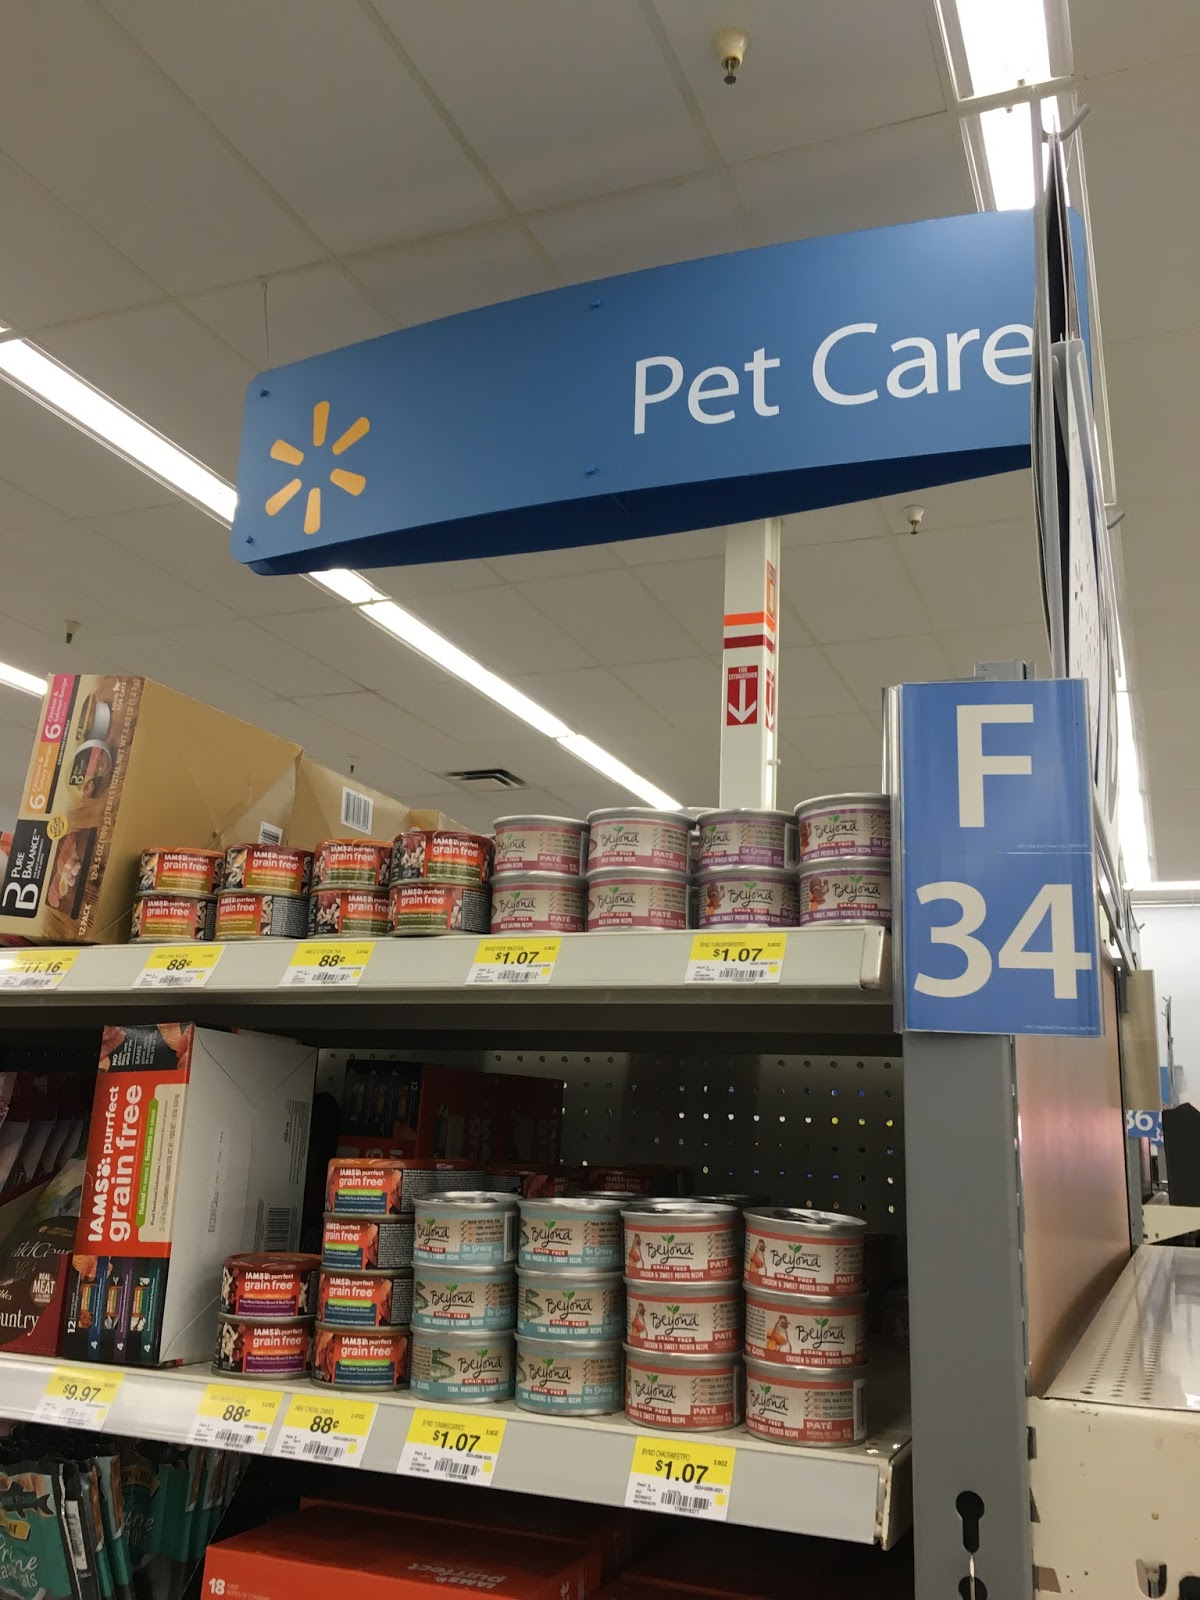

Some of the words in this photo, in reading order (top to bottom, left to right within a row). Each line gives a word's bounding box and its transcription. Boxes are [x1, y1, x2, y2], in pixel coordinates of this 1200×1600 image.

[634, 347, 781, 436] Pet
[812, 322, 1032, 407] Care
[45, 724, 61, 739] 6
[956, 703, 1034, 828] F
[111, 765, 121, 789] TOTAL
[29, 794, 45, 809] 6
[814, 822, 859, 841] Beyond
[601, 832, 640, 850] Beyond
[22, 834, 40, 879] BALANCE
[330, 852, 352, 862] grain
[354, 853, 374, 861] free
[433, 846, 459, 855] grain
[461, 848, 478, 857] free
[539, 854, 562, 862] PATÉ
[653, 850, 674, 859] PATÉ
[11, 852, 25, 878] PURE
[163, 861, 188, 870] grain
[189, 862, 207, 871] free
[252, 859, 277, 868] grain
[279, 860, 298, 869] free
[401, 895, 422, 905] grain
[424, 895, 444, 905] free
[728, 889, 773, 907] Beyond
[832, 883, 881, 902] Beyond
[147, 906, 168, 916] grain
[170, 906, 189, 915] free
[220, 904, 235, 913] grain
[347, 902, 373, 912] grain
[500, 899, 536, 916] Beyond
[598, 894, 635, 911] Beyond
[81, 904, 92, 926] PACK
[550, 914, 571, 923] PATÉ
[650, 910, 671, 918] PATÉ
[79, 926, 87, 936] 12
[914, 881, 1092, 1000] 34
[495, 952, 540, 964] $1.07
[713, 948, 763, 962] $1.07
[115, 1084, 142, 1150] free
[88, 1179, 109, 1242] IAMS
[103, 1085, 119, 1154] purrfect
[339, 1176, 360, 1187] grain
[363, 1176, 383, 1186] free
[109, 1155, 135, 1242] grain
[138, 1193, 146, 1215] flaked
[325, 1231, 342, 1241] grain
[344, 1232, 359, 1241] free
[417, 1224, 450, 1244] Beyond
[531, 1227, 572, 1247] Beyond
[646, 1243, 694, 1264] Beyond
[771, 1250, 821, 1273] Beyond
[246, 1272, 264, 1280] IAMS
[32, 1279, 55, 1295] MEAT
[244, 1281, 270, 1291] grain
[272, 1281, 292, 1290] free
[329, 1287, 350, 1298] grain
[352, 1288, 372, 1297] free
[431, 1290, 475, 1311] Beyond
[546, 1299, 593, 1319] Beyond
[0, 1309, 40, 1337] untry
[67, 1321, 77, 1334] 12
[650, 1313, 699, 1335] Beyond
[254, 1328, 273, 1336] IAMS
[342, 1336, 361, 1344] IAMS
[796, 1326, 845, 1349] Beyond
[91, 1340, 98, 1349] 4
[117, 1342, 124, 1351] 4
[144, 1344, 151, 1353] 4
[253, 1336, 280, 1347] grain
[281, 1336, 301, 1346] free
[341, 1346, 367, 1357] grain
[369, 1346, 391, 1356] free
[458, 1356, 502, 1378] Beyond
[529, 1365, 572, 1386] Beyond
[62, 1384, 101, 1402] $9.97
[634, 1380, 676, 1404] Beyond
[750, 1390, 789, 1415] Beyond
[222, 1405, 251, 1422] 88¢
[309, 1415, 339, 1434] 88¢
[806, 1421, 832, 1429] PATÉ
[432, 1430, 481, 1453] $1.07
[655, 1460, 709, 1484] $1.07
[209, 1578, 226, 1596] 18
